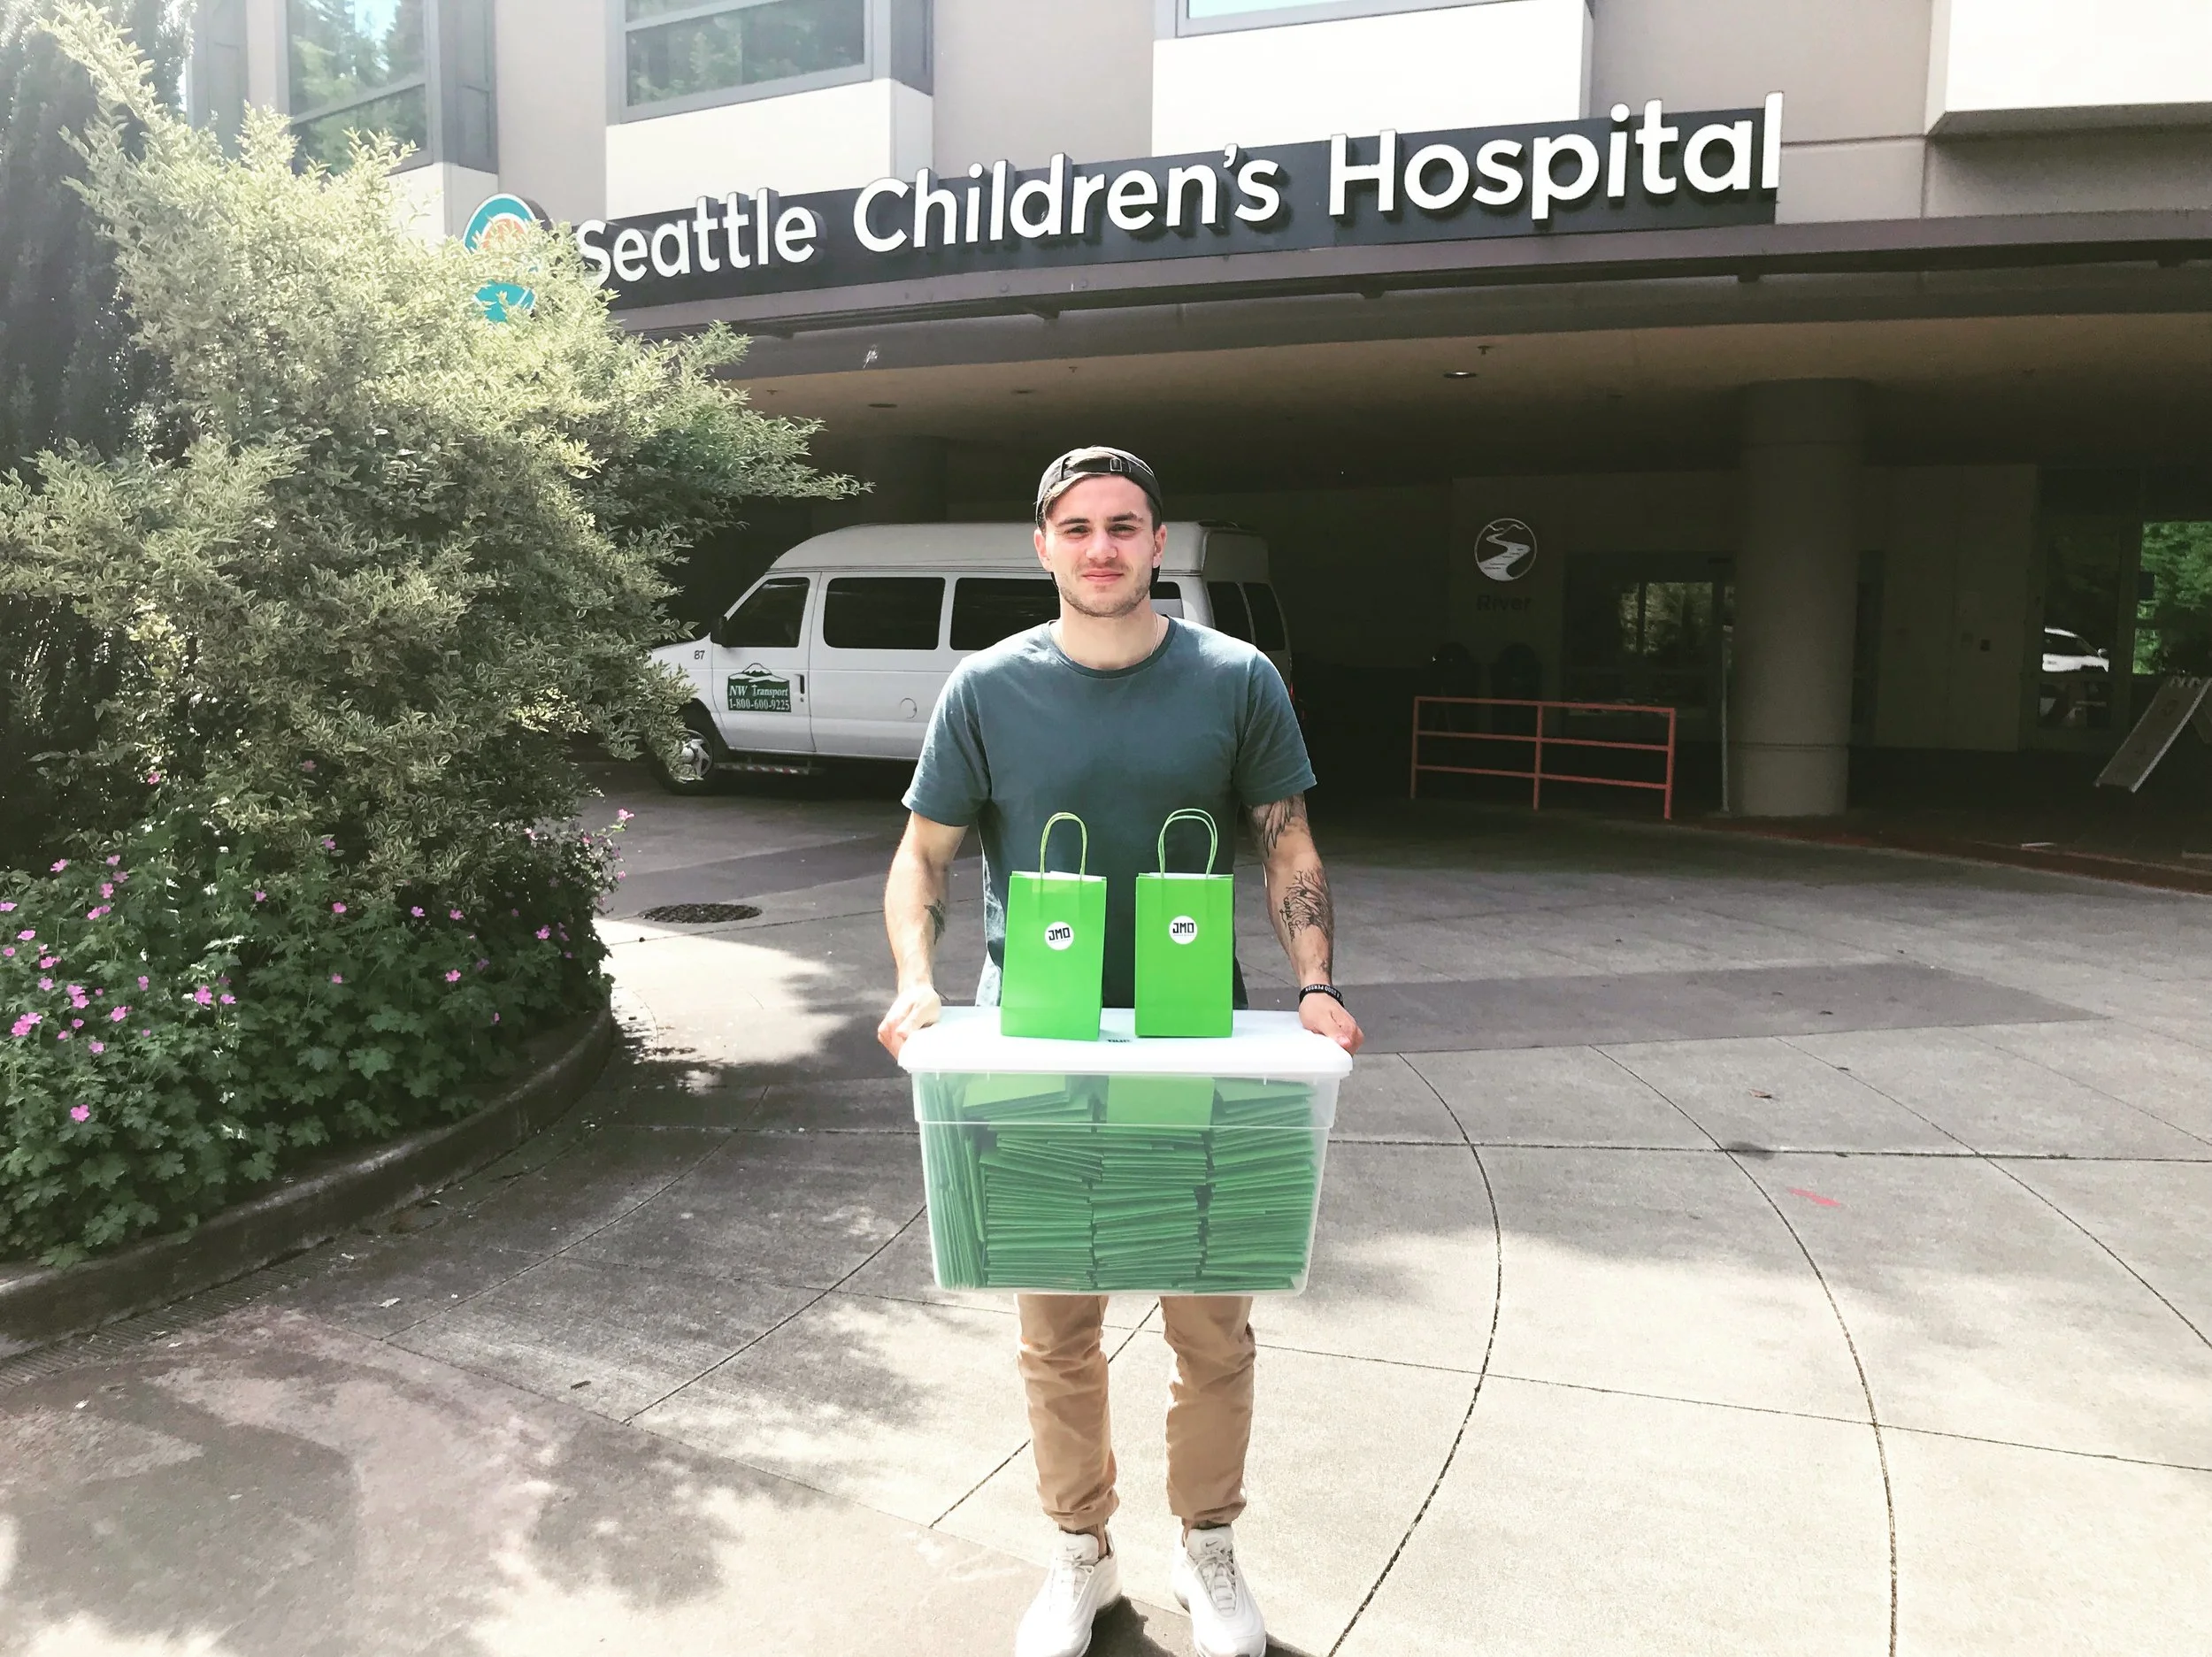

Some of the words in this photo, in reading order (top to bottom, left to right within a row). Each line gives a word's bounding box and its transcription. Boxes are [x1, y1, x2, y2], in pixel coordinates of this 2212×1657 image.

[576, 187, 818, 288] Seattle
[854, 143, 1280, 253] Children's
[1328, 91, 1784, 220] Hospital
[1477, 595, 1532, 611] River
[694, 650, 705, 660] 87
[729, 685, 748, 696] NW
[751, 685, 788, 698] Transport
[729, 698, 790, 710] 1-800-600-9225
